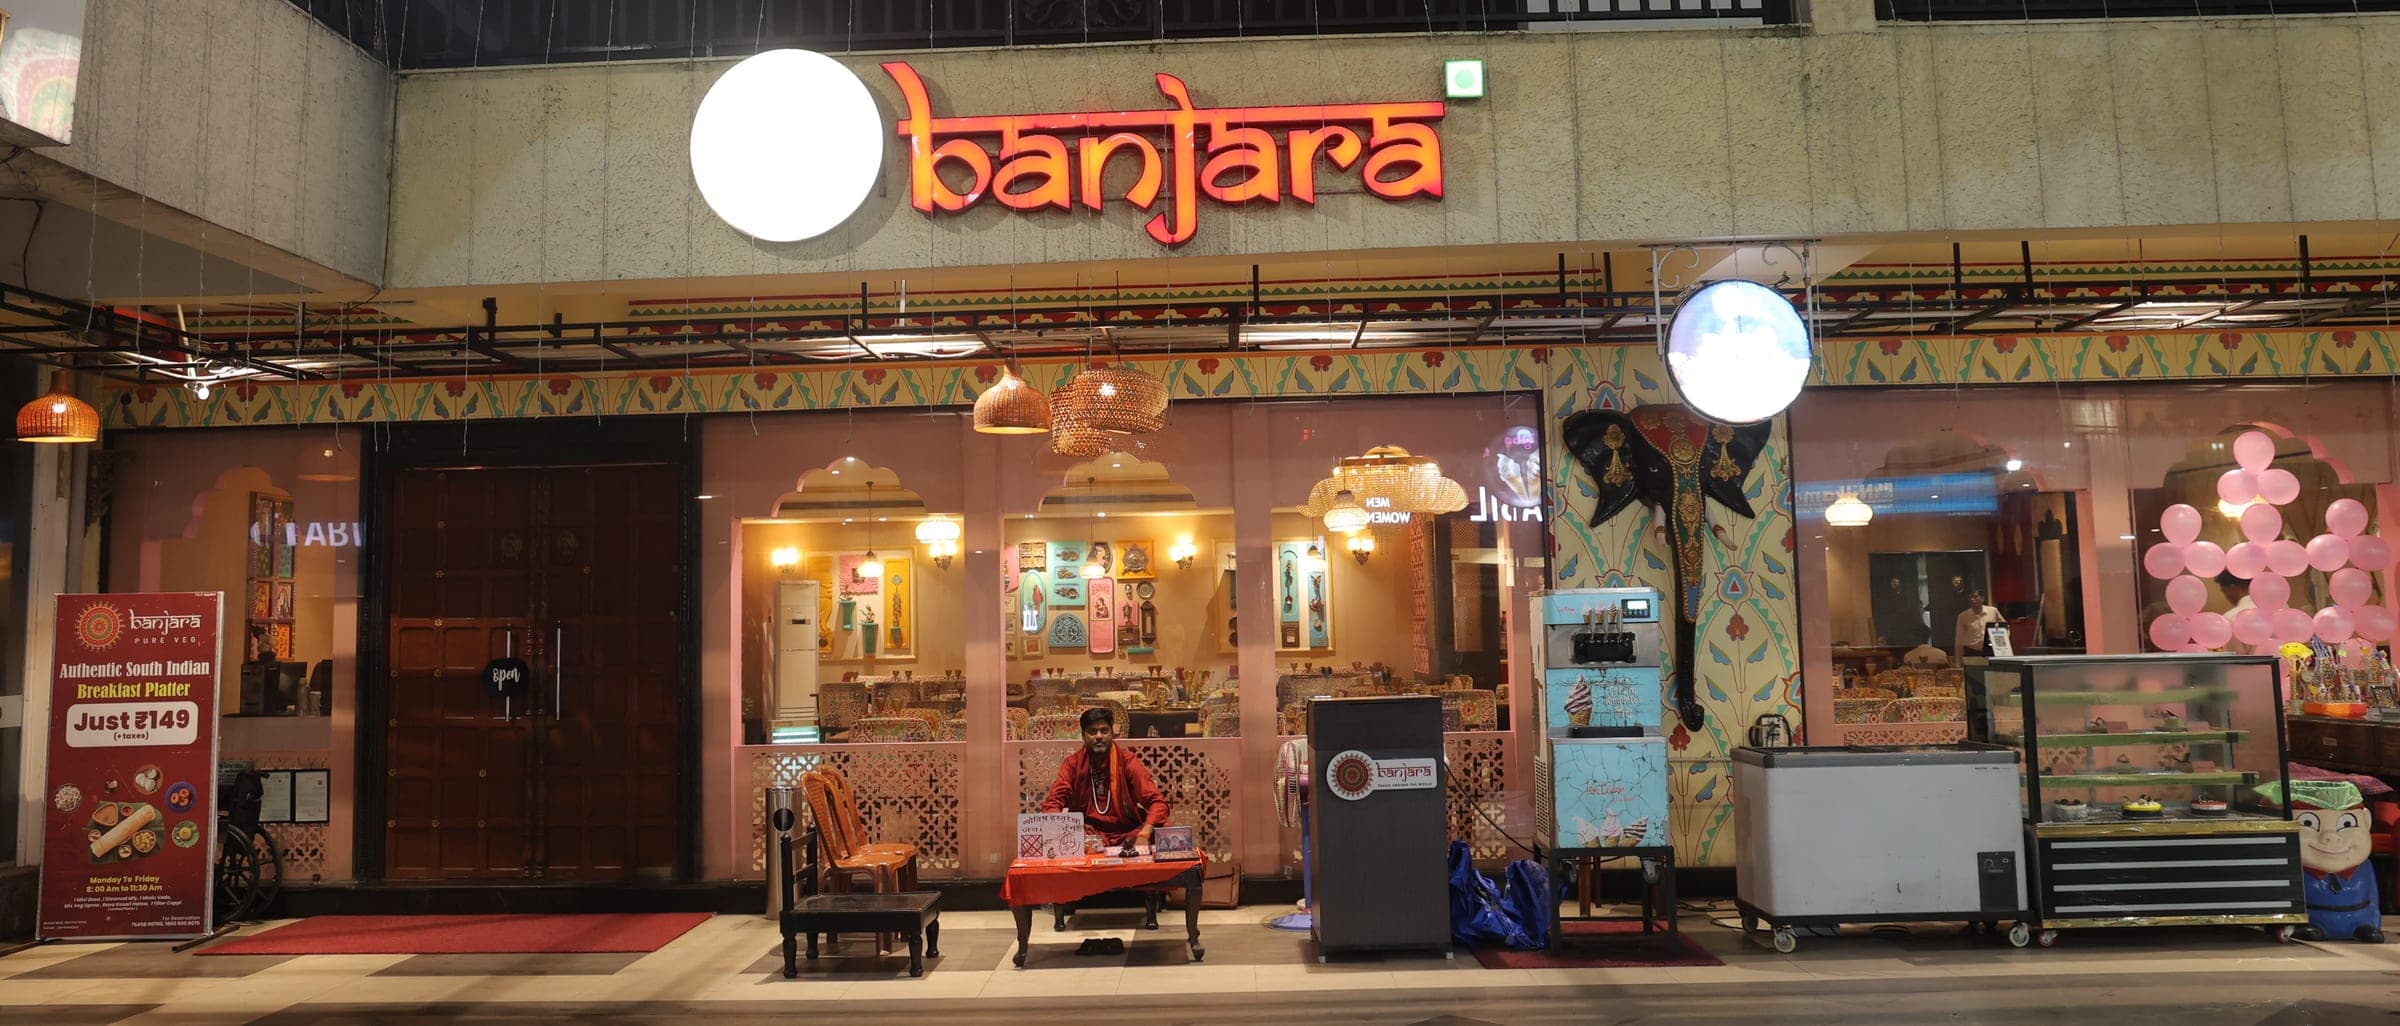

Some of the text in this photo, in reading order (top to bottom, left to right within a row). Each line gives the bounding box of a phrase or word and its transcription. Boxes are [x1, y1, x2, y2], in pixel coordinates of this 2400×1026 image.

[880, 61, 1445, 246] banjara
[128, 608, 201, 635] banjara
[134, 637, 166, 645] PURE
[59, 659, 210, 679] Authentic South Indian
[77, 681, 191, 699] Breakfast Platter
[74, 708, 190, 731] Just ₹149
[1375, 761, 1432, 783] banjara
[89, 876, 122, 885] Monday
[134, 874, 161, 884] Friday
[121, 884, 129, 892] to
[148, 883, 163, 891] Am
